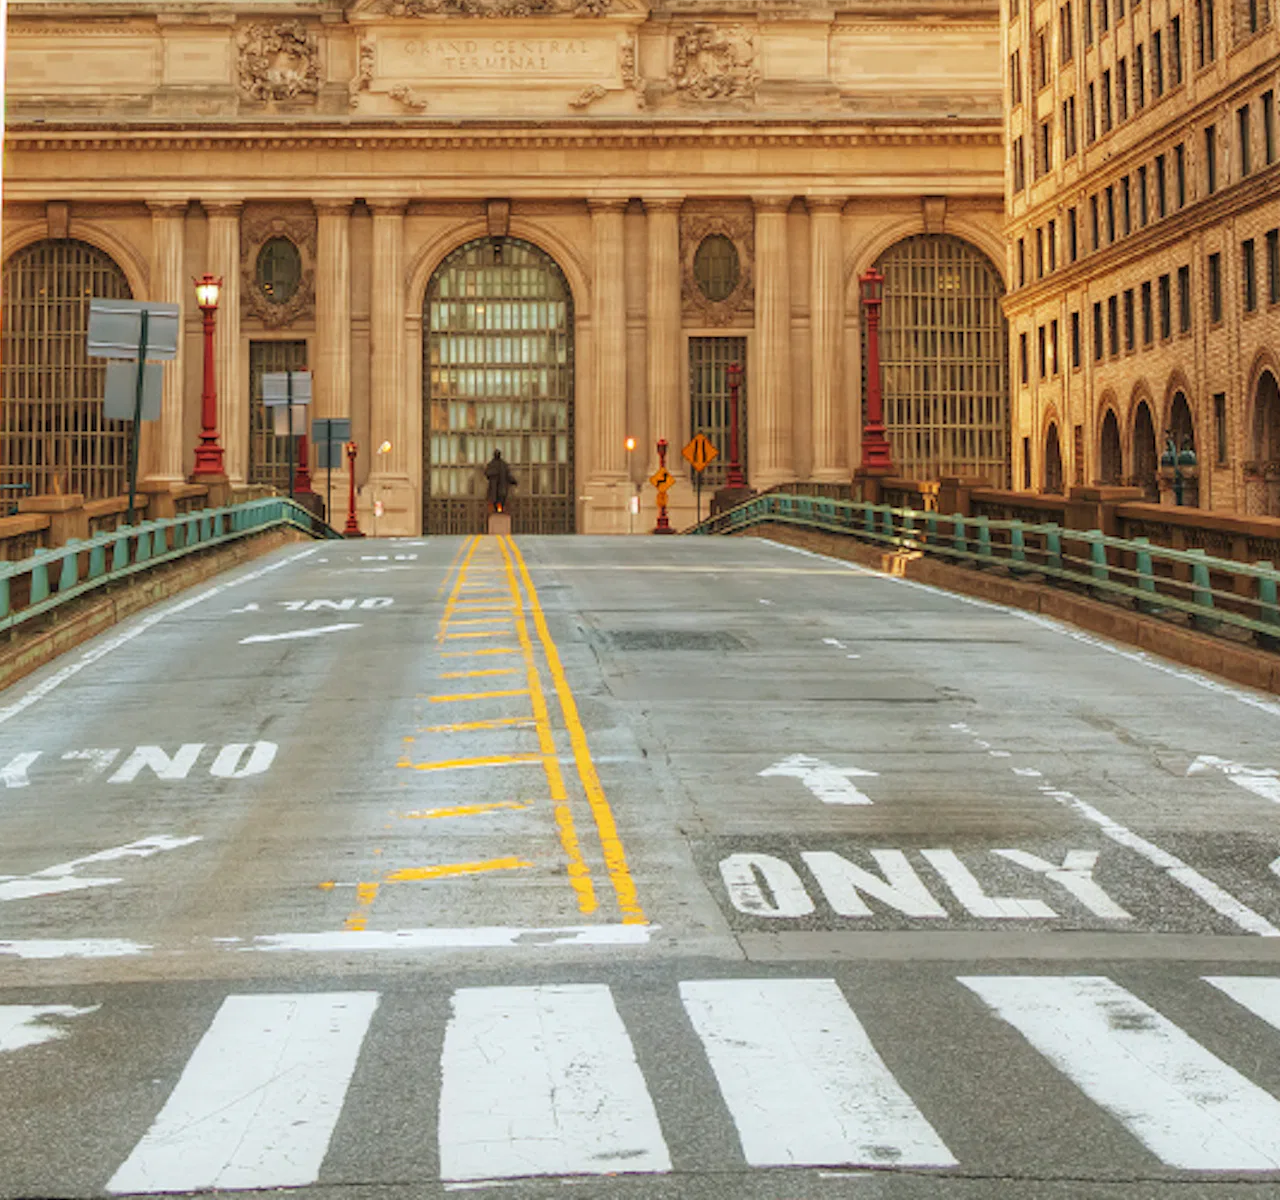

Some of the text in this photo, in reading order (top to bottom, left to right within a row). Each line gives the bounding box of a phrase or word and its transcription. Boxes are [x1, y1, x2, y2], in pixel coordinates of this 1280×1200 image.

[403, 39, 590, 55] GRAND CENTRAL
[444, 56, 549, 71] TERMINAL
[719, 848, 1135, 919] ONLY
